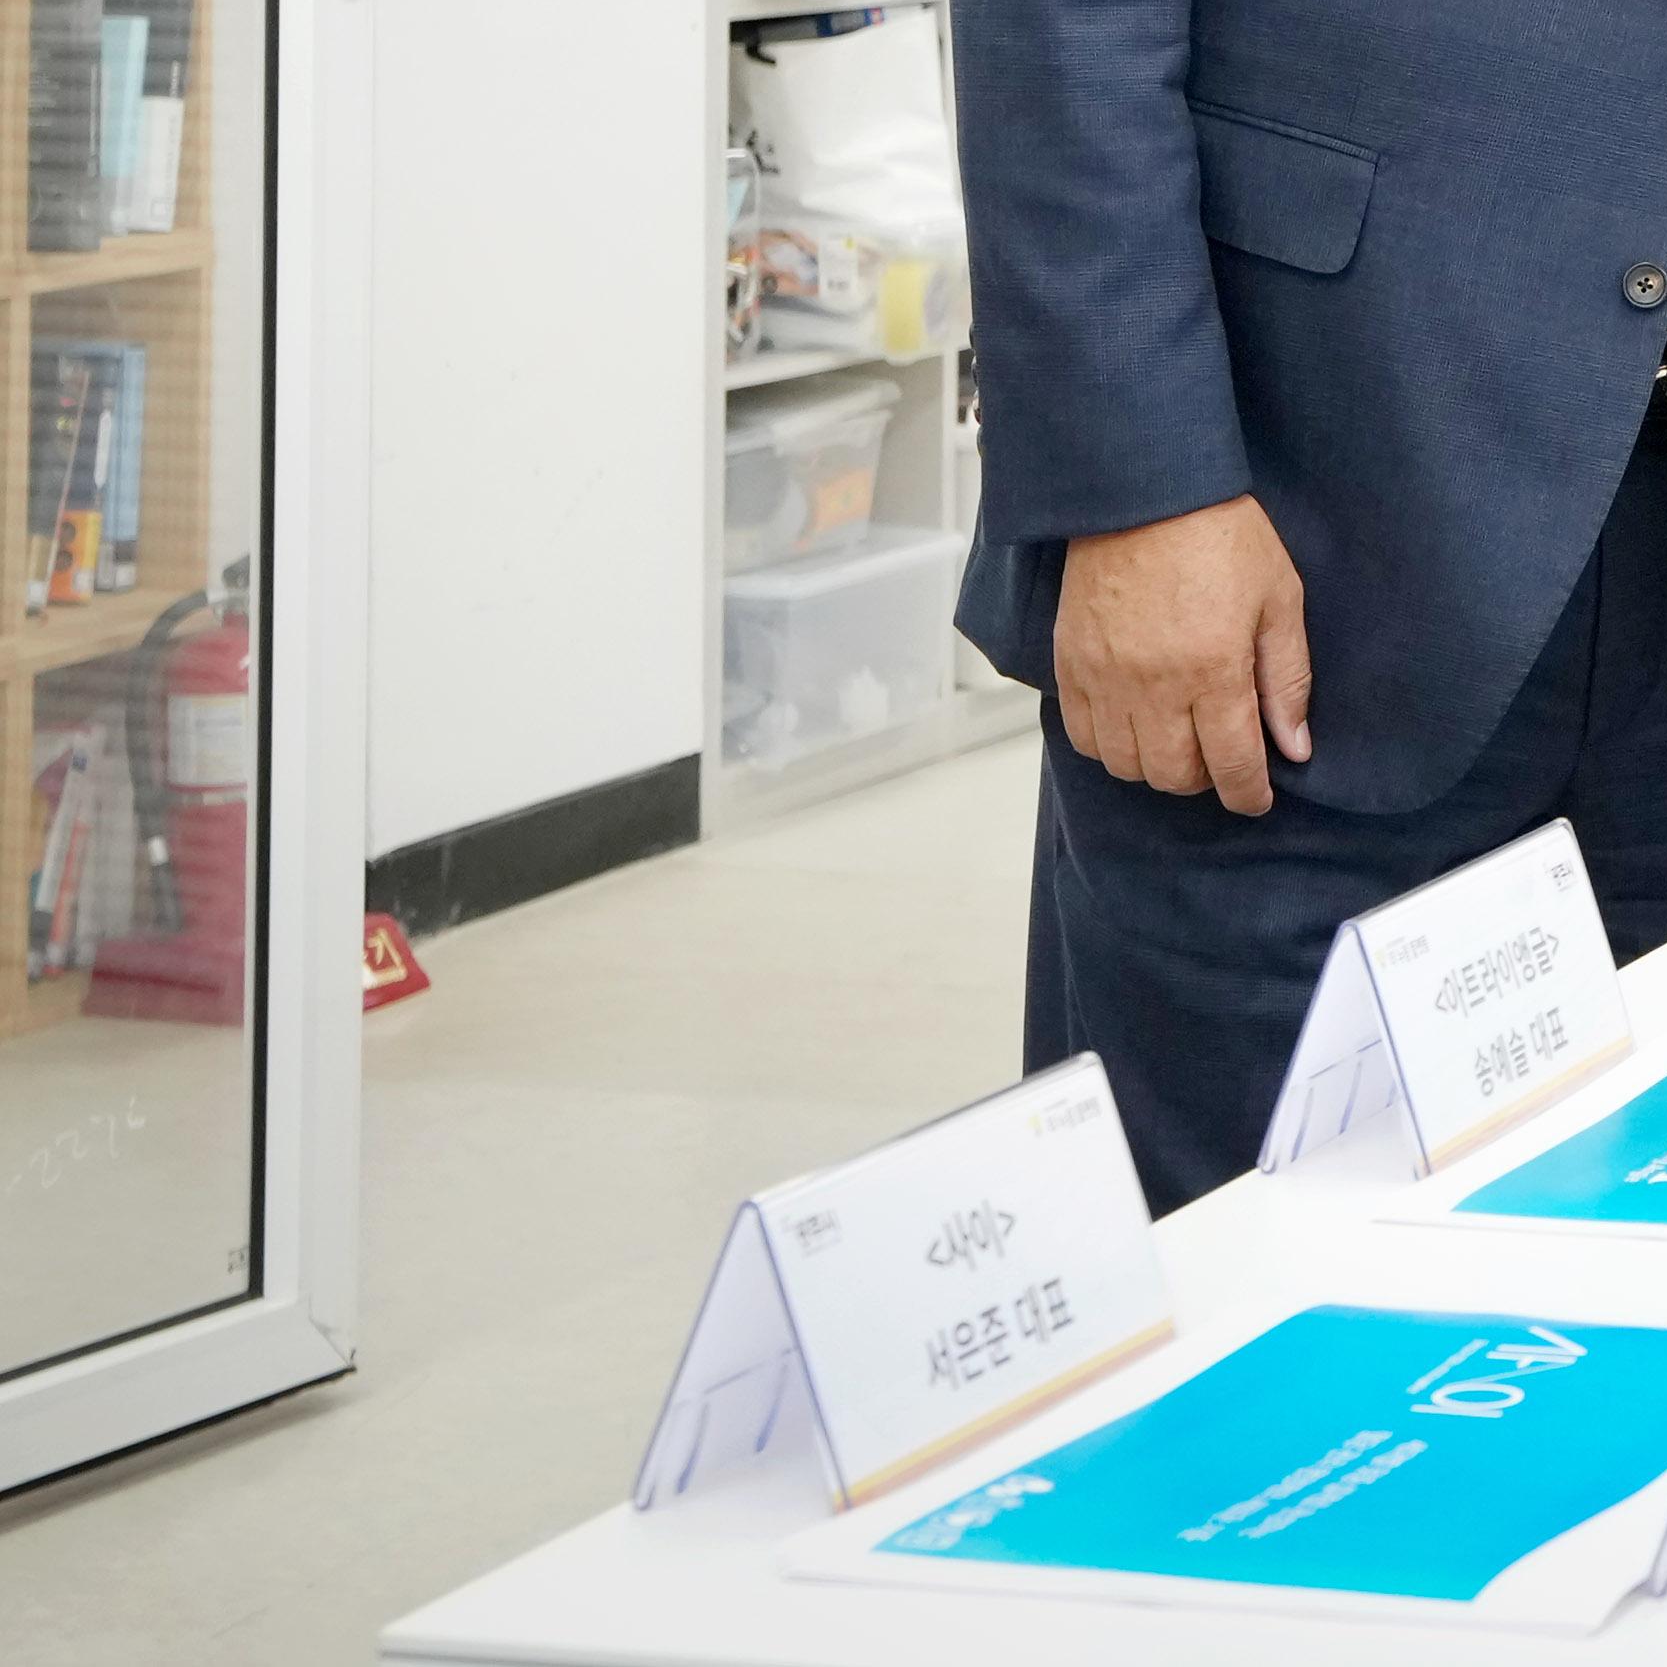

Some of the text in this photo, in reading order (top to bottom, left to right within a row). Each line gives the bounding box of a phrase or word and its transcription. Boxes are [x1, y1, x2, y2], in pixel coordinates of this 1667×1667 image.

[1435, 926, 1560, 1019] <아트라이앵글>
[1475, 1005, 1569, 1098] 송예슬 대표
[926, 1199, 1016, 1271] <사이>
[926, 1276, 1075, 1391] 서은준 대표
